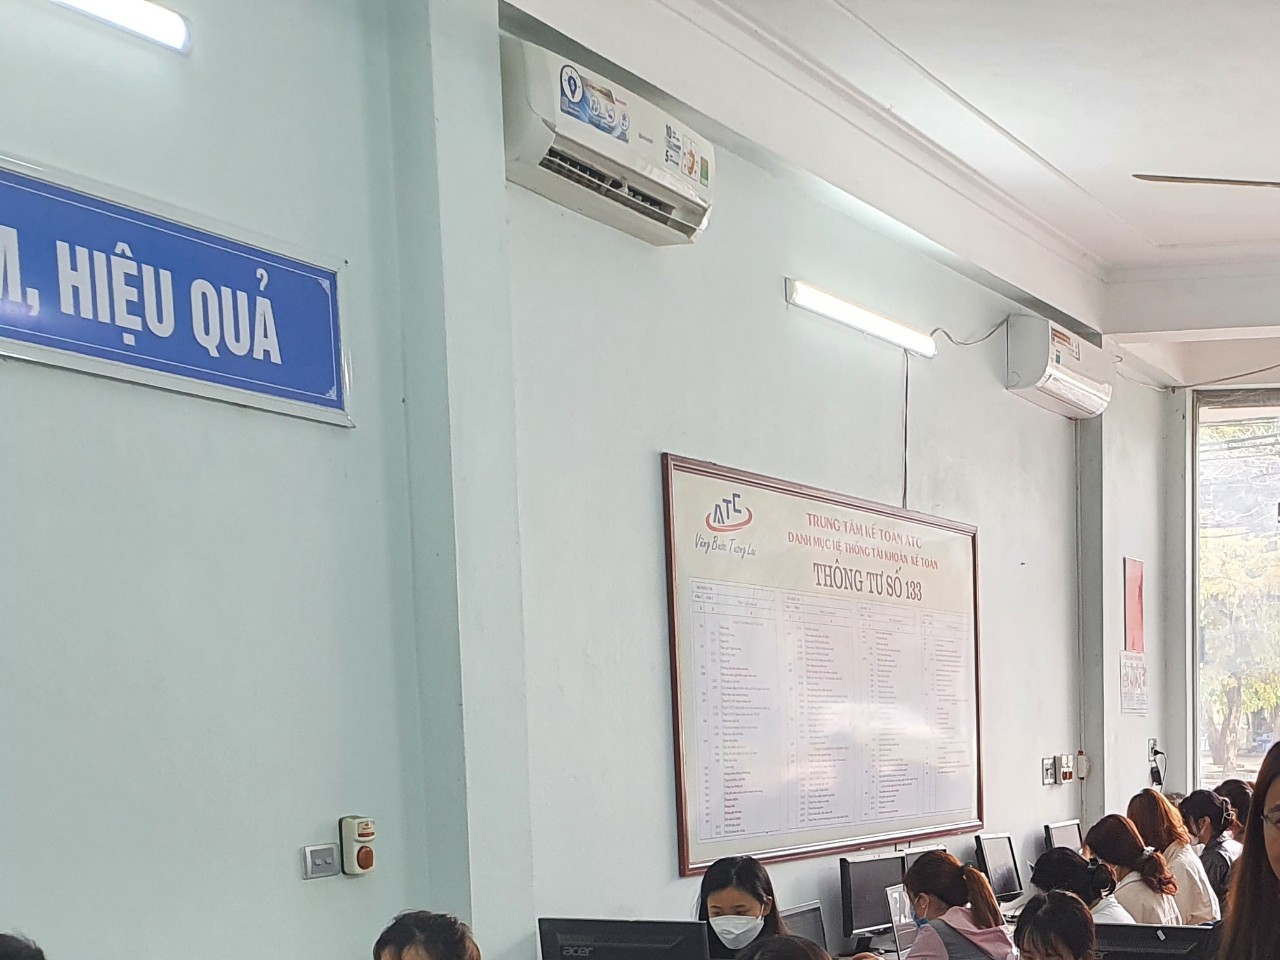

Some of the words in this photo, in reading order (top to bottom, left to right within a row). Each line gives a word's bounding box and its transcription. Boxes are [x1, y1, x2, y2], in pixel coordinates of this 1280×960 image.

[56, 240, 175, 346] HIỆU
[190, 268, 282, 365] QUẢ
[713, 493, 742, 524] ATC
[788, 531, 812, 546] DANH
[806, 513, 841, 532] TRUNG
[904, 533, 922, 550] ATC
[813, 558, 864, 593] THÔNG
[866, 570, 885, 595] TƯ
[886, 566, 903, 598] SỐ
[905, 580, 923, 601] 133
[562, 946, 594, 956] acer
